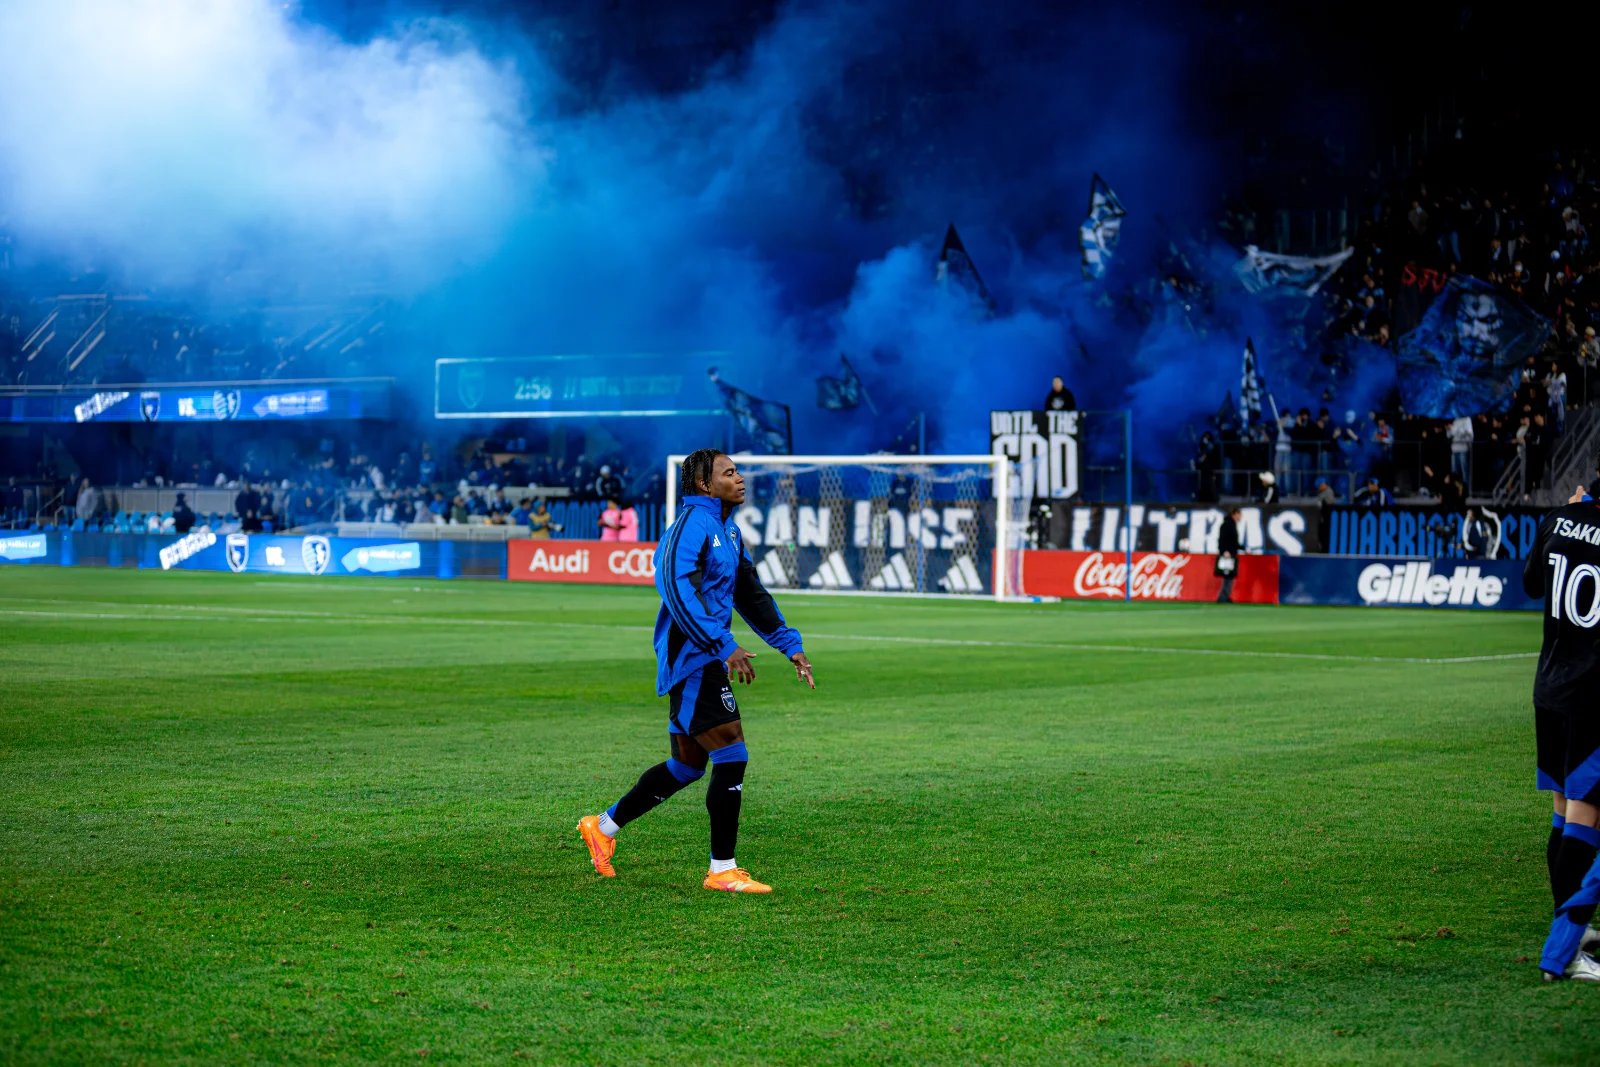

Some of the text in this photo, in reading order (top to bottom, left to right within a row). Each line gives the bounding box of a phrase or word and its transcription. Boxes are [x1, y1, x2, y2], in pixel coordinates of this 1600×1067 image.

[991, 411, 1079, 435] UNTIL THE
[734, 503, 831, 548] SAN
[529, 548, 589, 574] Audi
[1357, 562, 1503, 607] Gillette
[1548, 552, 1600, 629] 10
